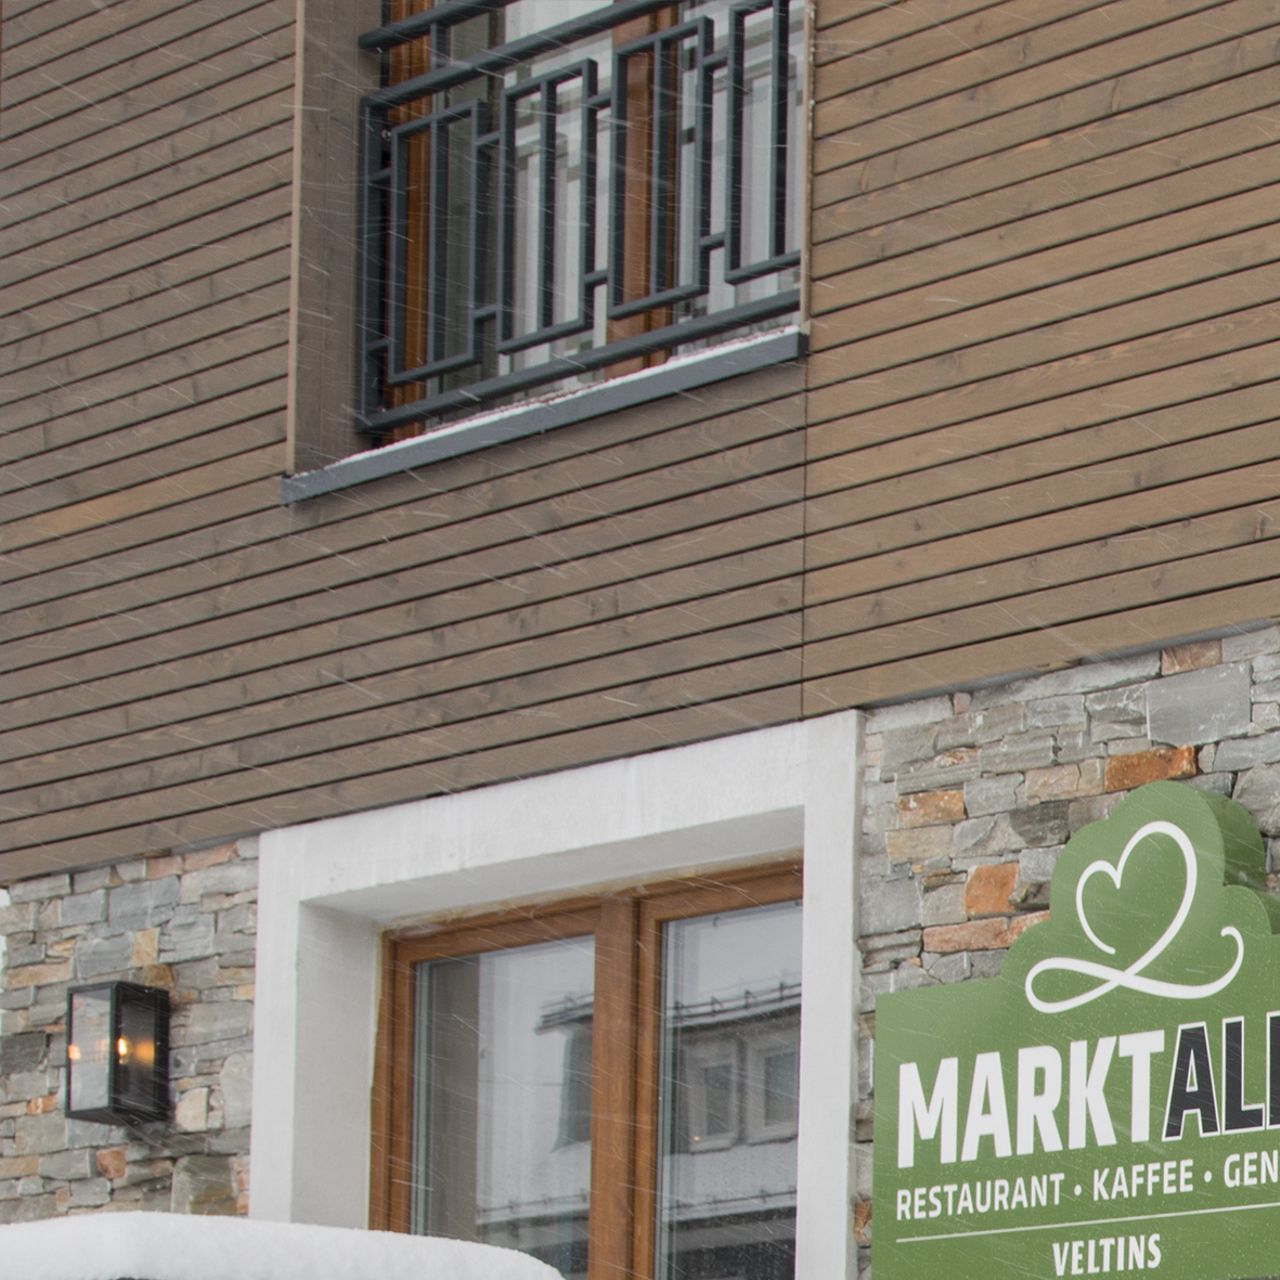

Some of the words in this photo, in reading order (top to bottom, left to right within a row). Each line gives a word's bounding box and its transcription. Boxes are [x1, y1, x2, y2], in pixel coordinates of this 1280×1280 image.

[896, 1172, 1065, 1221] RESTAURANT
[1093, 1159, 1194, 1202] KAFFEE
[1052, 1233, 1162, 1277] VELTINS
